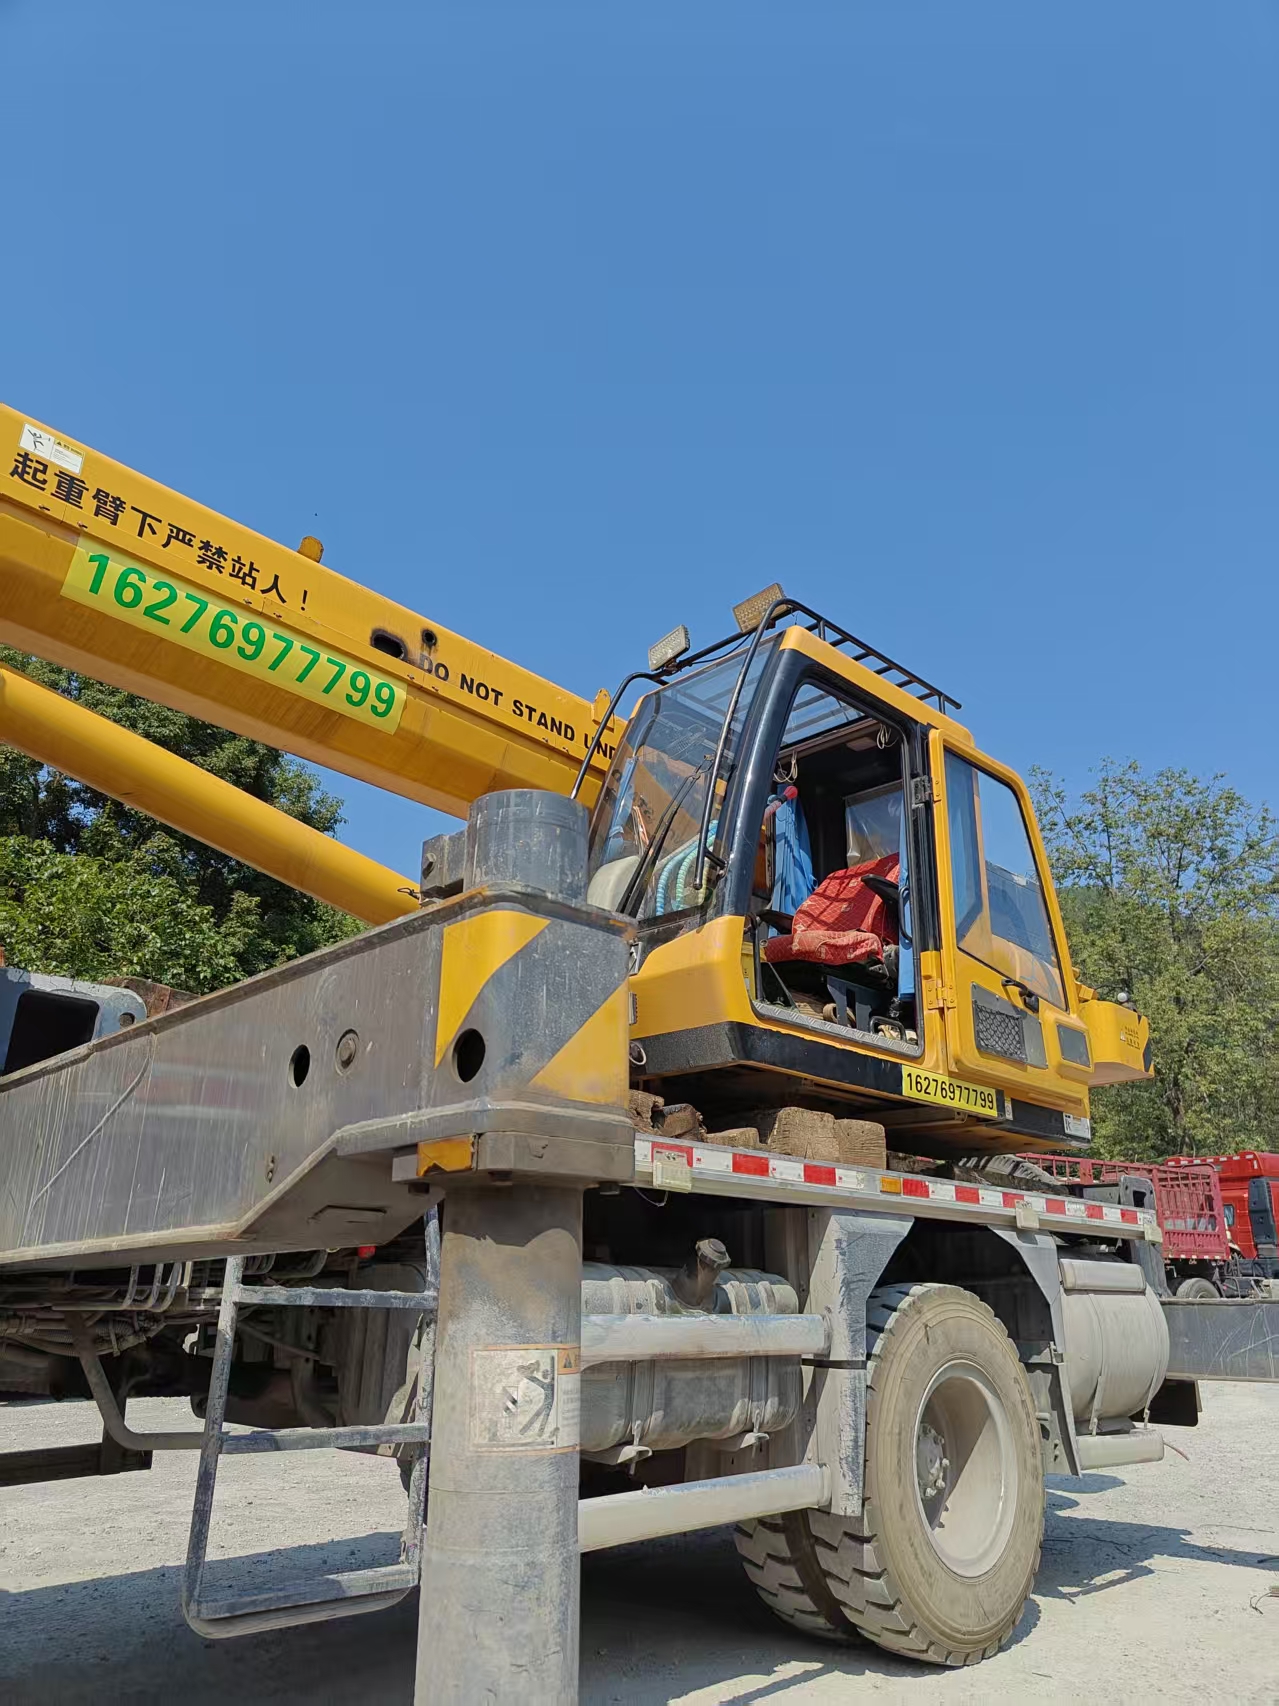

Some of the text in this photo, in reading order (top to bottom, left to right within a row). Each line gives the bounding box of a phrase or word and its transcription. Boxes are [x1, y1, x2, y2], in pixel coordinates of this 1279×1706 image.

[9, 451, 309, 611] 起重臂下严禁站人！
[87, 553, 397, 719] 16276977799
[419, 653, 450, 682] DO
[460, 673, 504, 707] NOT
[512, 699, 576, 742] STAND
[906, 1072, 995, 1110] 16276977799
